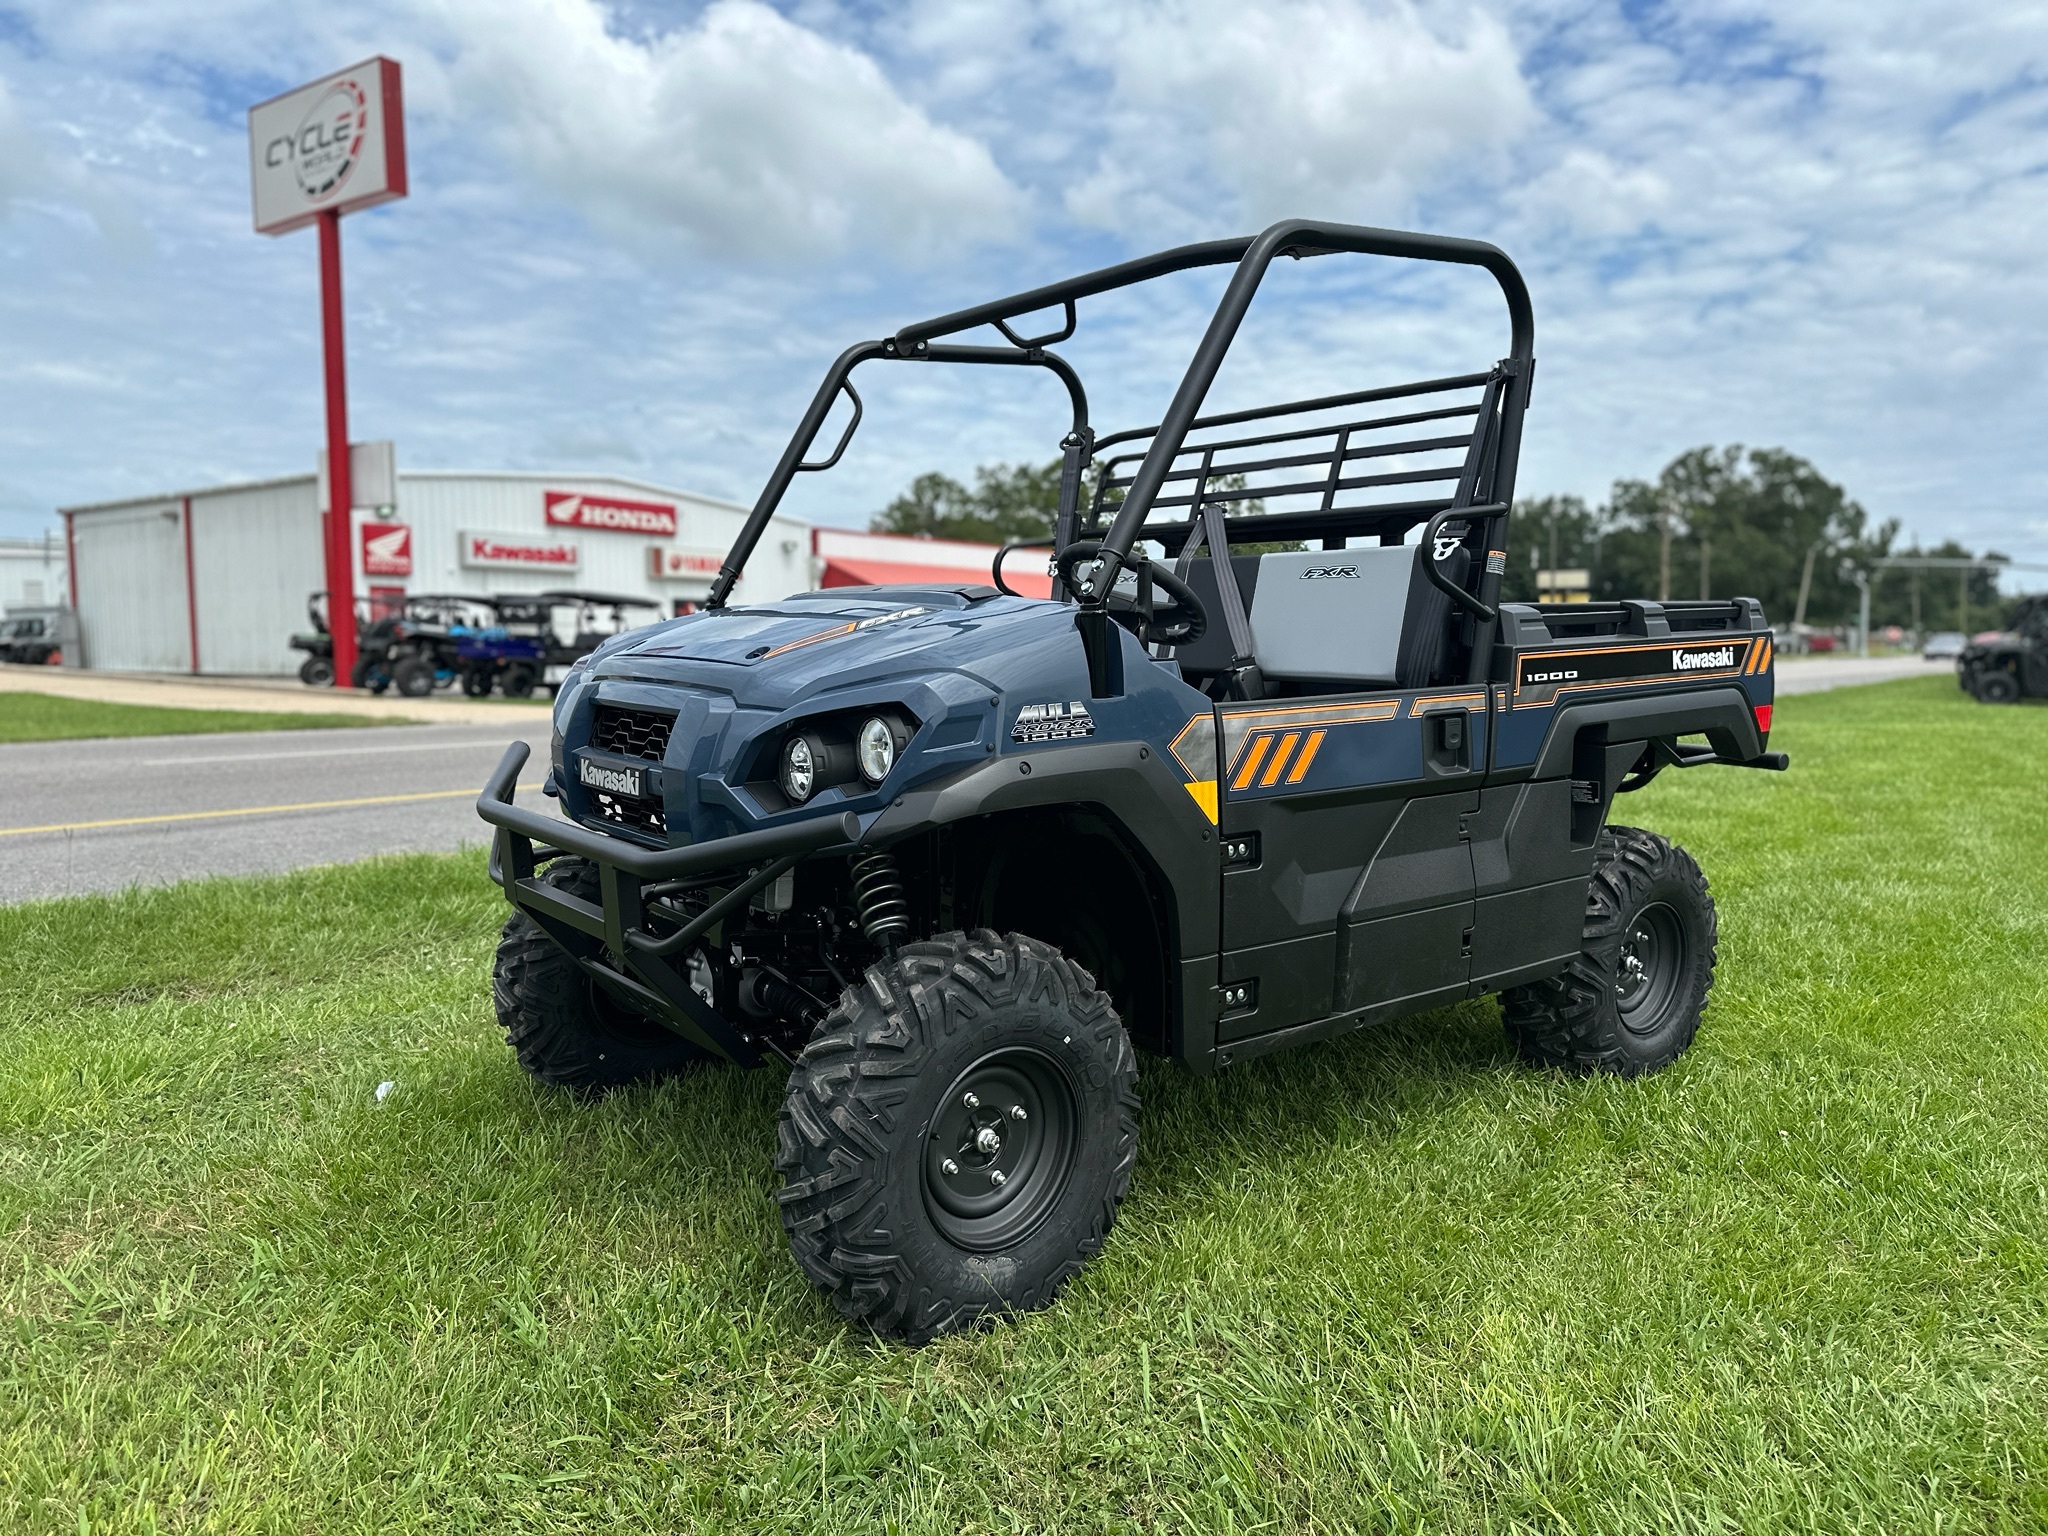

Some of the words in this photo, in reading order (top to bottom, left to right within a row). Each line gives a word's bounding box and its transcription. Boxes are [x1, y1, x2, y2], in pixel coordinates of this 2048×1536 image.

[265, 113, 351, 168] CYCLE
[581, 505, 675, 533] HONDA
[473, 539, 576, 565] Kawasaki
[1299, 564, 1361, 579] FXR
[1672, 646, 1734, 670] Kawasaki
[1527, 670, 1578, 682] 1000
[1015, 701, 1092, 725] MULE
[1023, 729, 1087, 742] 1000
[580, 758, 640, 796] Kawasaki
